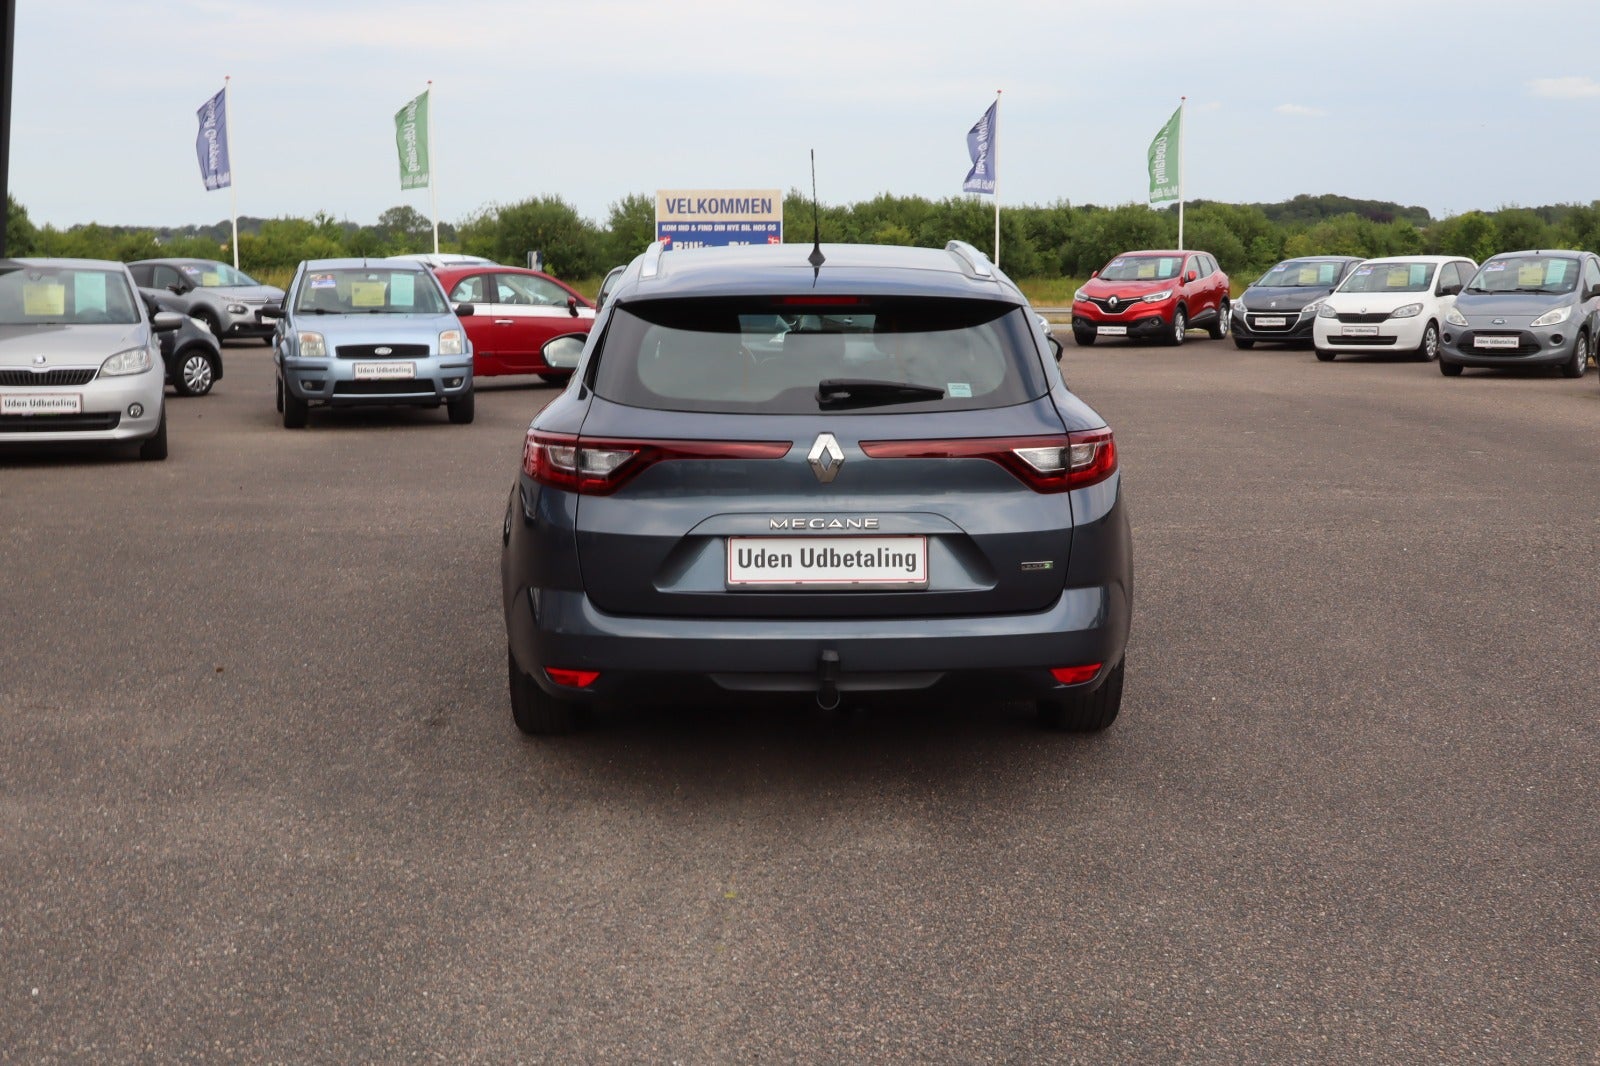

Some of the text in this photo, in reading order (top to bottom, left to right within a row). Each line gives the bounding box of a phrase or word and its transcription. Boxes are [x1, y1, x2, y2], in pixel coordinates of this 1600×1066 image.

[666, 198, 772, 213] VELKOMMEN
[662, 224, 677, 232] KOM
[698, 224, 713, 232] FIND
[358, 366, 412, 374] Uden Udbetaling
[4, 398, 77, 408] Uden Udbetaling
[769, 518, 881, 530] MEGANE
[737, 547, 917, 573] Uden Udbetaling
